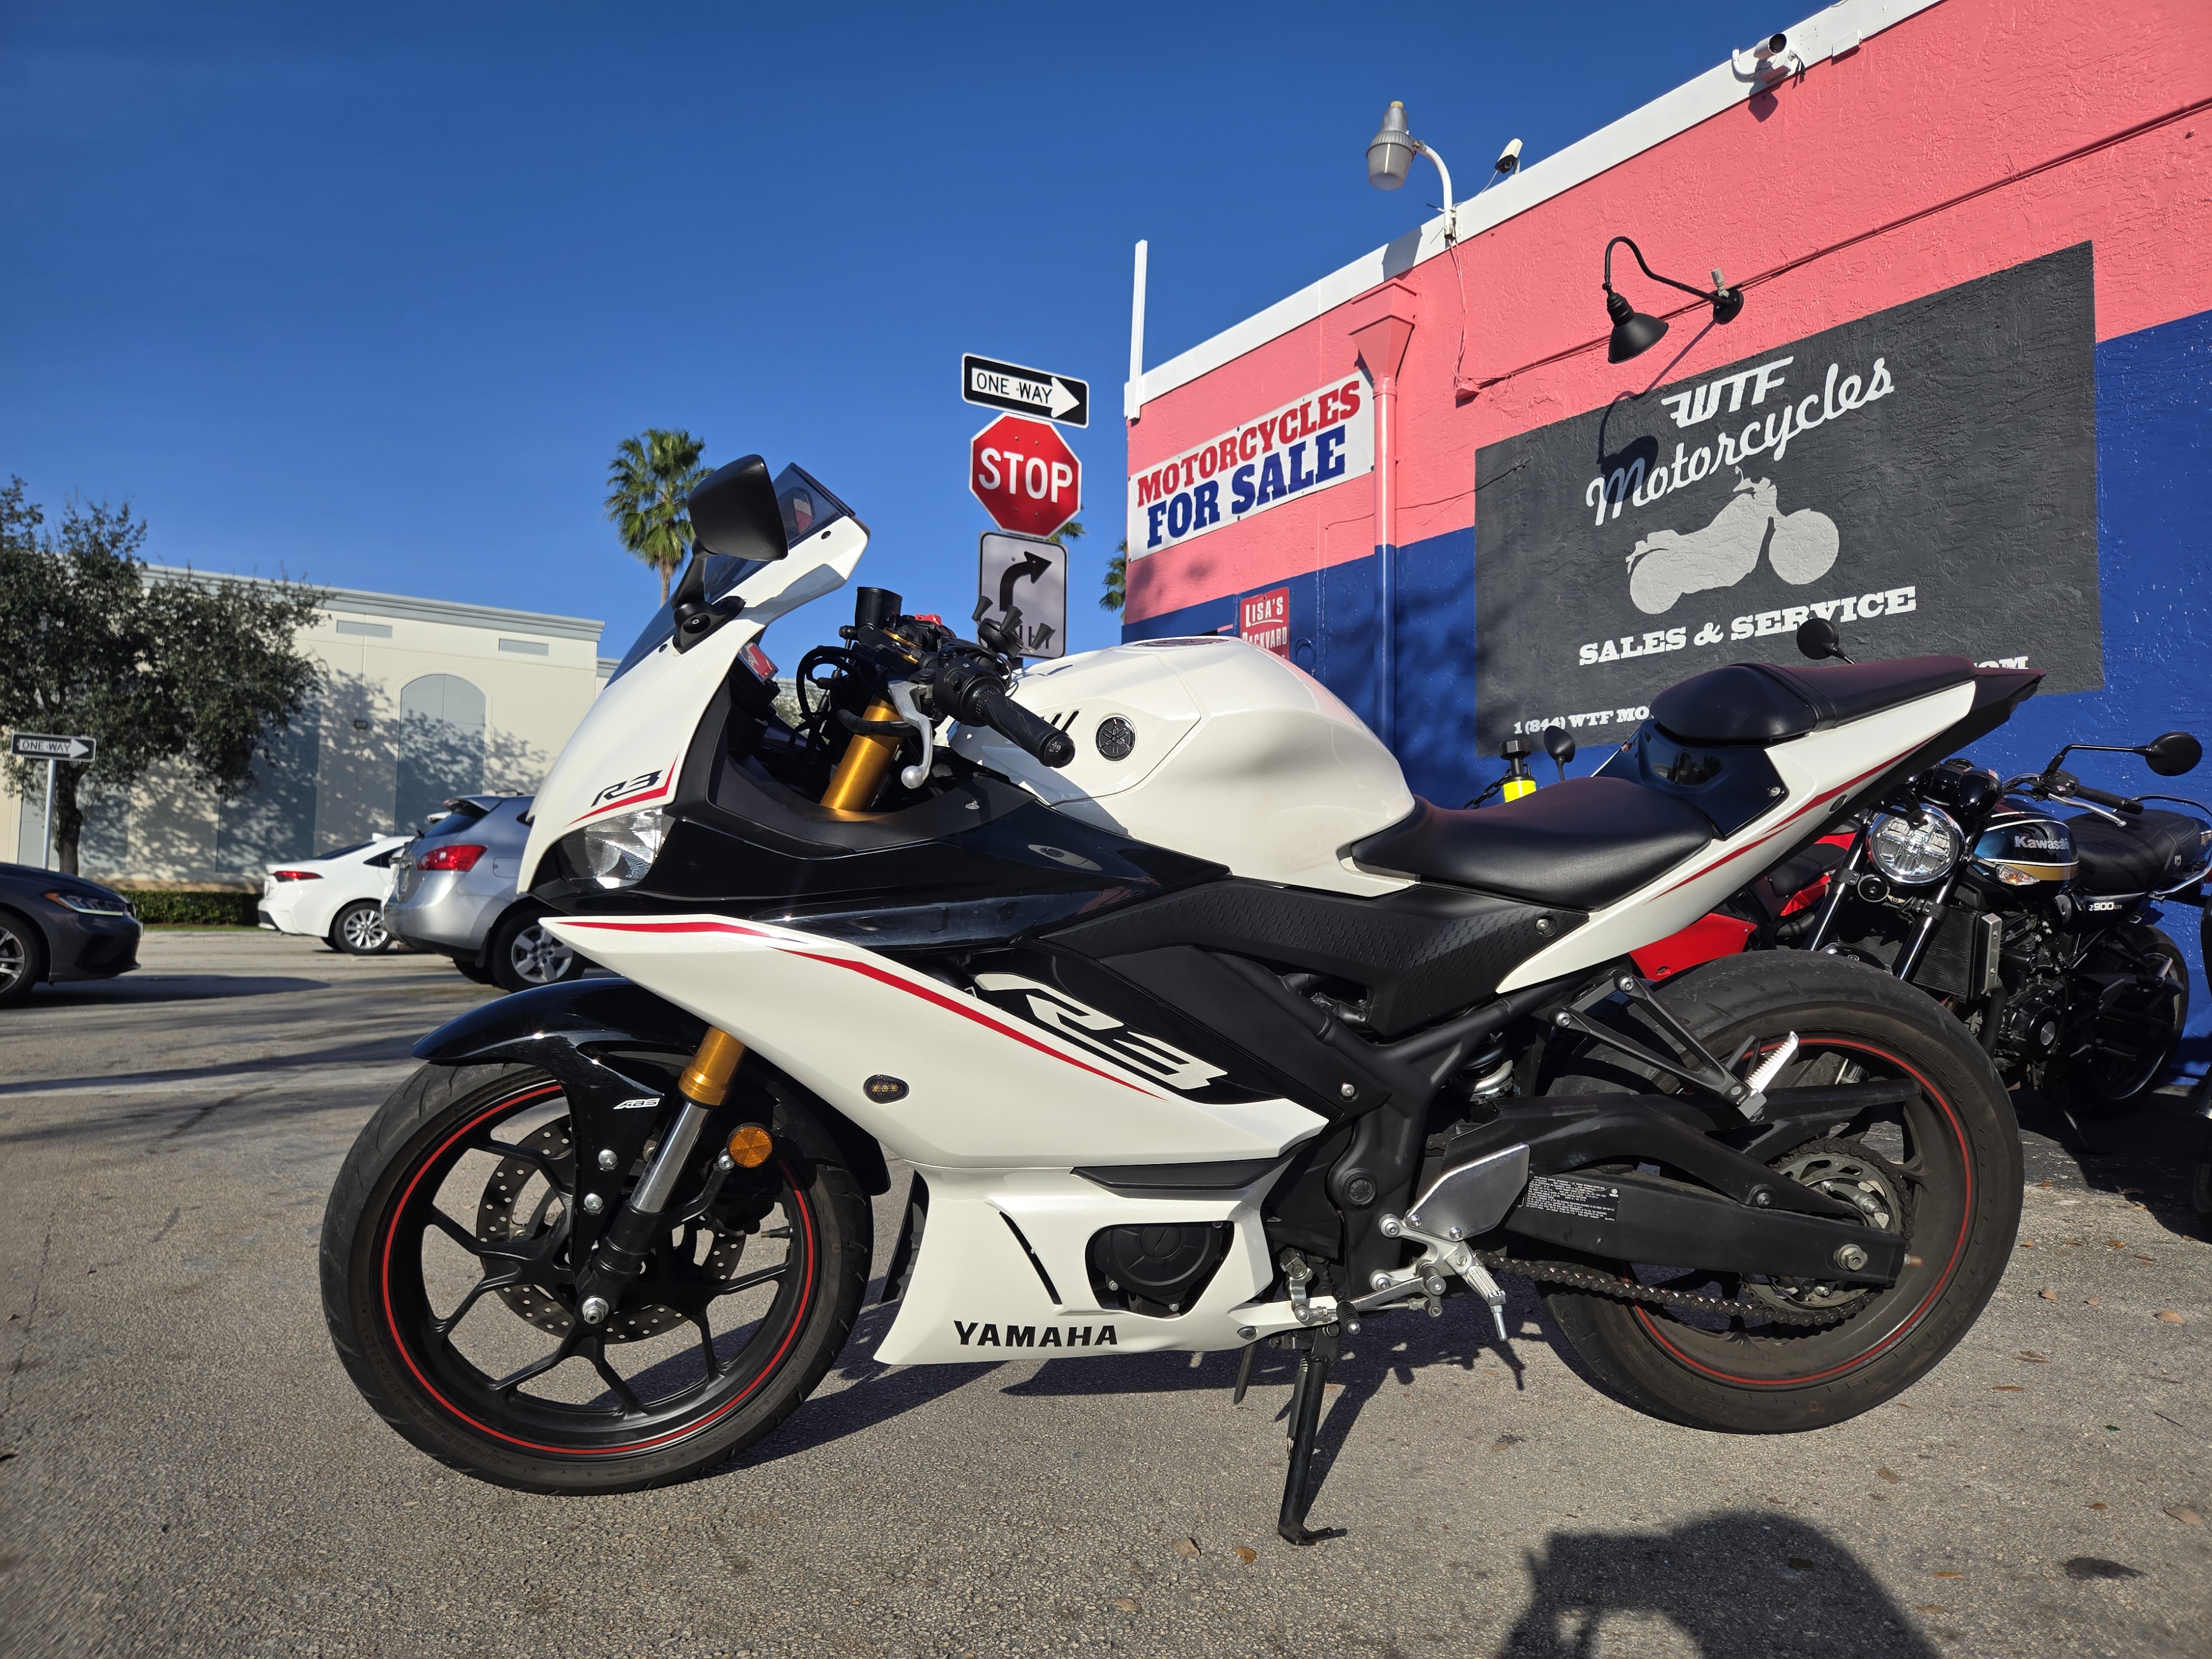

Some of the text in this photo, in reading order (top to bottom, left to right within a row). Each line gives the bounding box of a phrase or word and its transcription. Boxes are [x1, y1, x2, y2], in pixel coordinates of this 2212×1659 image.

[977, 372, 1053, 404] ONE WAY
[1661, 356, 1794, 429] WTF
[1138, 380, 1361, 507] MOTORCYCLES
[1585, 357, 1895, 526] Motorcycles
[978, 447, 1073, 503] STOP
[1147, 425, 1345, 549] FOR SALE
[1245, 596, 1284, 628] LISA'S
[1579, 586, 1917, 666] SALES & SERVICE
[1568, 710, 1614, 728] WTF
[22, 740, 71, 753] ONE WAY
[591, 770, 662, 807] R3
[2015, 836, 2069, 850] Kawasaki
[974, 973, 1228, 1090] R3
[613, 1098, 661, 1110] ABS
[953, 1320, 1118, 1347] YAMAHA
[406, 1402, 503, 1466] SPORTMAX
